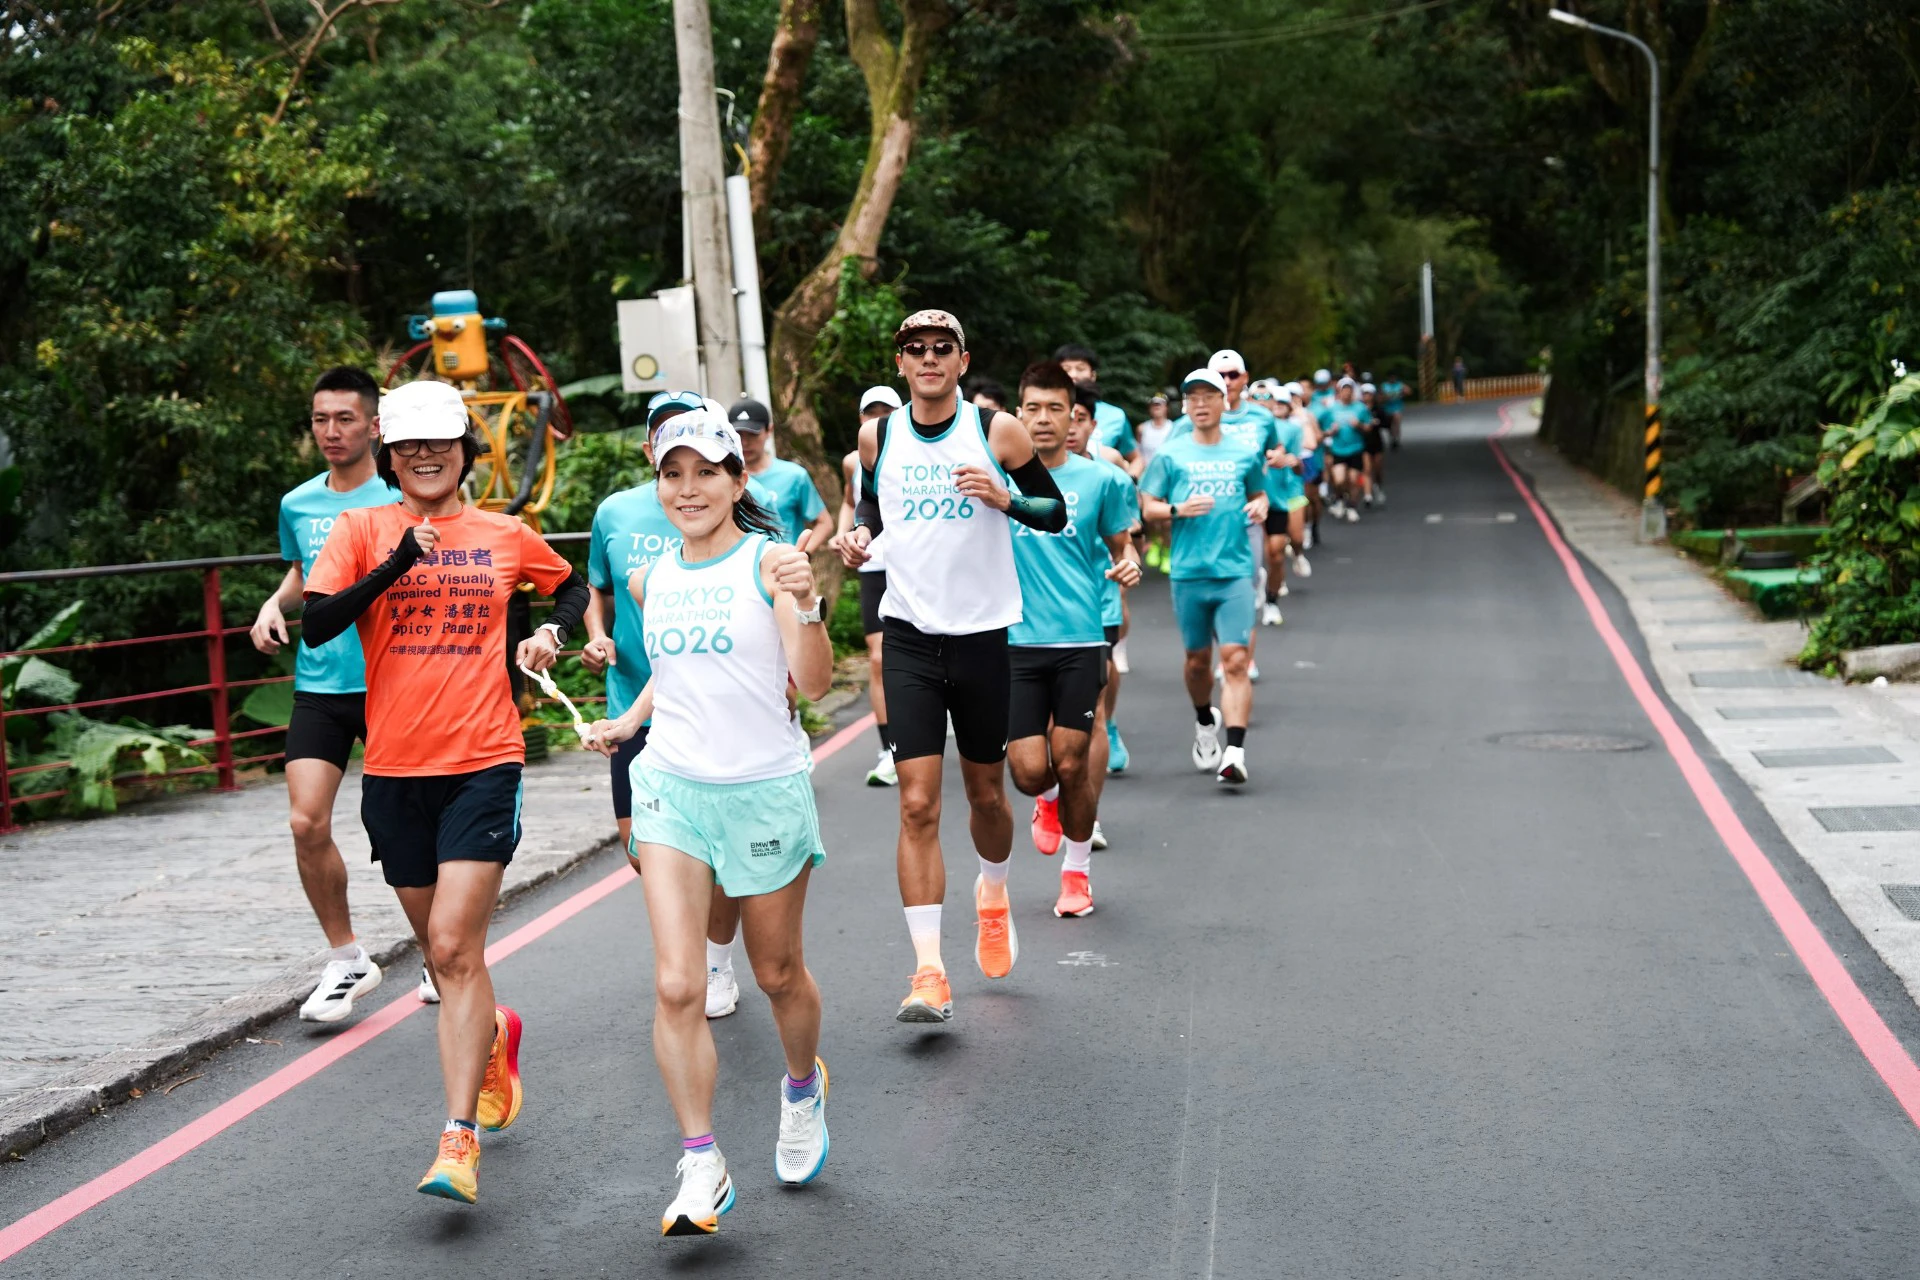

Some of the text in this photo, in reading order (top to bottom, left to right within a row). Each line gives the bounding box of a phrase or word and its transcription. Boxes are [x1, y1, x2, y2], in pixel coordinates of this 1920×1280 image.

[902, 463, 968, 482] TOKY
[1187, 461, 1236, 473] TOKYO
[902, 483, 971, 496] MARATHO
[1188, 481, 1237, 496] 2026
[902, 497, 974, 521] 2026
[630, 532, 685, 553] TOK
[387, 548, 492, 568] 障跑者
[437, 573, 494, 588] Visually
[386, 587, 494, 602] Impaired Runner
[653, 586, 735, 609] TOKYO
[391, 603, 490, 621] 美少女 潘蜜拉
[647, 608, 731, 627] MARATHON
[441, 621, 488, 635] Pamela
[646, 625, 734, 660] 2026
